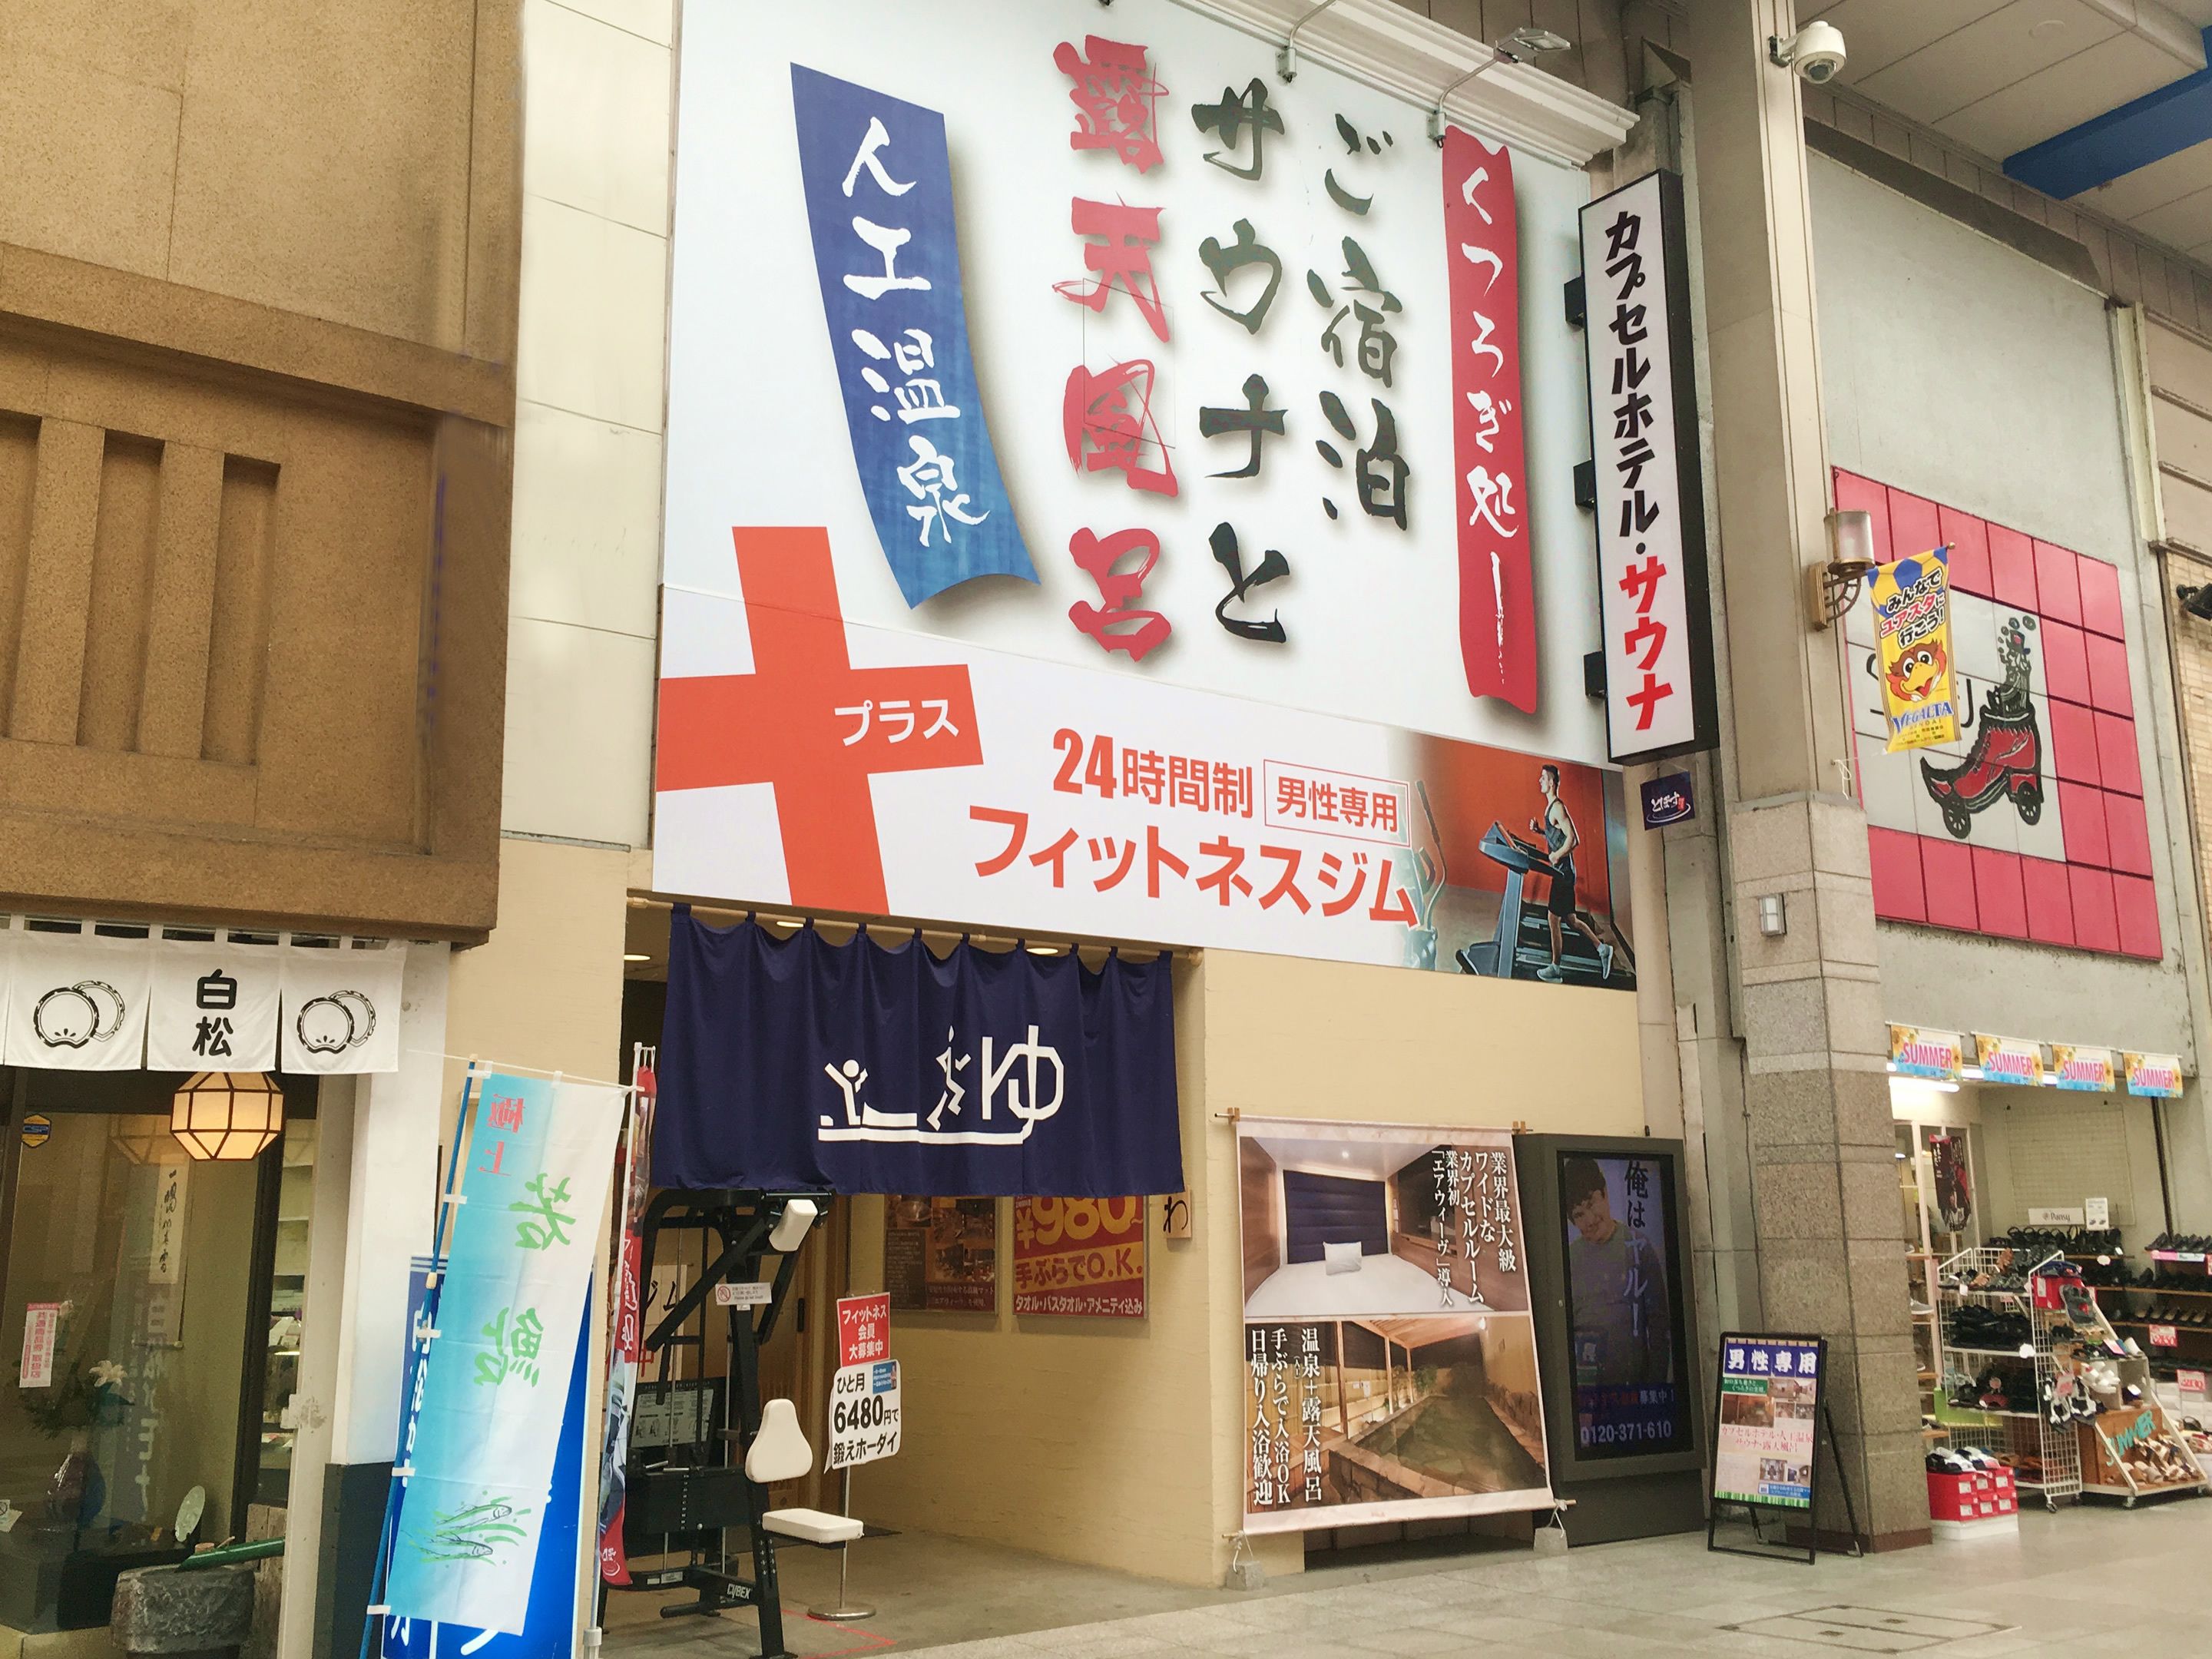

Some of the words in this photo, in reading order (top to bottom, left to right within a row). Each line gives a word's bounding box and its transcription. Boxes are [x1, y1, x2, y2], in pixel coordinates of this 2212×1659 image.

[842, 116, 991, 548] 人工温泉
[1307, 113, 1409, 531] ご宿泊
[1191, 78, 1290, 644] サウナと
[1888, 569, 1941, 612] みんなで
[1882, 594, 1945, 637] ユアスタに
[834, 700, 959, 746] プラス
[1892, 700, 1953, 733] VEGALTA
[1052, 728, 1253, 819] 24時間制
[1275, 777, 1399, 832] 男性専用
[969, 806, 1421, 927] フィットネスジム
[192, 969, 238, 1057] 白松
[1903, 1042, 1953, 1069] SUMMER
[1988, 1051, 2035, 1076] SUMMER
[2063, 1060, 2105, 1082] SUMMER
[2134, 1068, 2175, 1088] SUMMER
[1445, 1150, 1460, 1207] 業界初
[1475, 1151, 1496, 1243] ワイドな
[1163, 1196, 1189, 1233] わ
[1460, 1151, 1485, 1304] カプセルルーム
[1491, 1151, 1517, 1273] 業界最大級
[2050, 1212, 2071, 1221] Pansy
[1015, 1247, 1143, 1289] 手ぶらでO.K.
[843, 1304, 887, 1326] フィットネス
[1015, 1295, 1143, 1314] タオル・バスタオル・アメニティ込み
[849, 1339, 883, 1361] 大募集中
[858, 1323, 876, 1341] 会員
[1728, 1348, 1816, 1374] 男性専用
[837, 1373, 865, 1394] ひと月
[833, 1394, 899, 1434] 6480円で
[1250, 1328, 1273, 1505] 日帰り入浴歓迎
[1270, 1327, 1290, 1504] 手ぶらで入浴OK
[1580, 1419, 1672, 1445] 0120-371-610
[833, 1431, 898, 1465] 鍛えホーダイ
[727, 1583, 751, 1600] CYBEX
